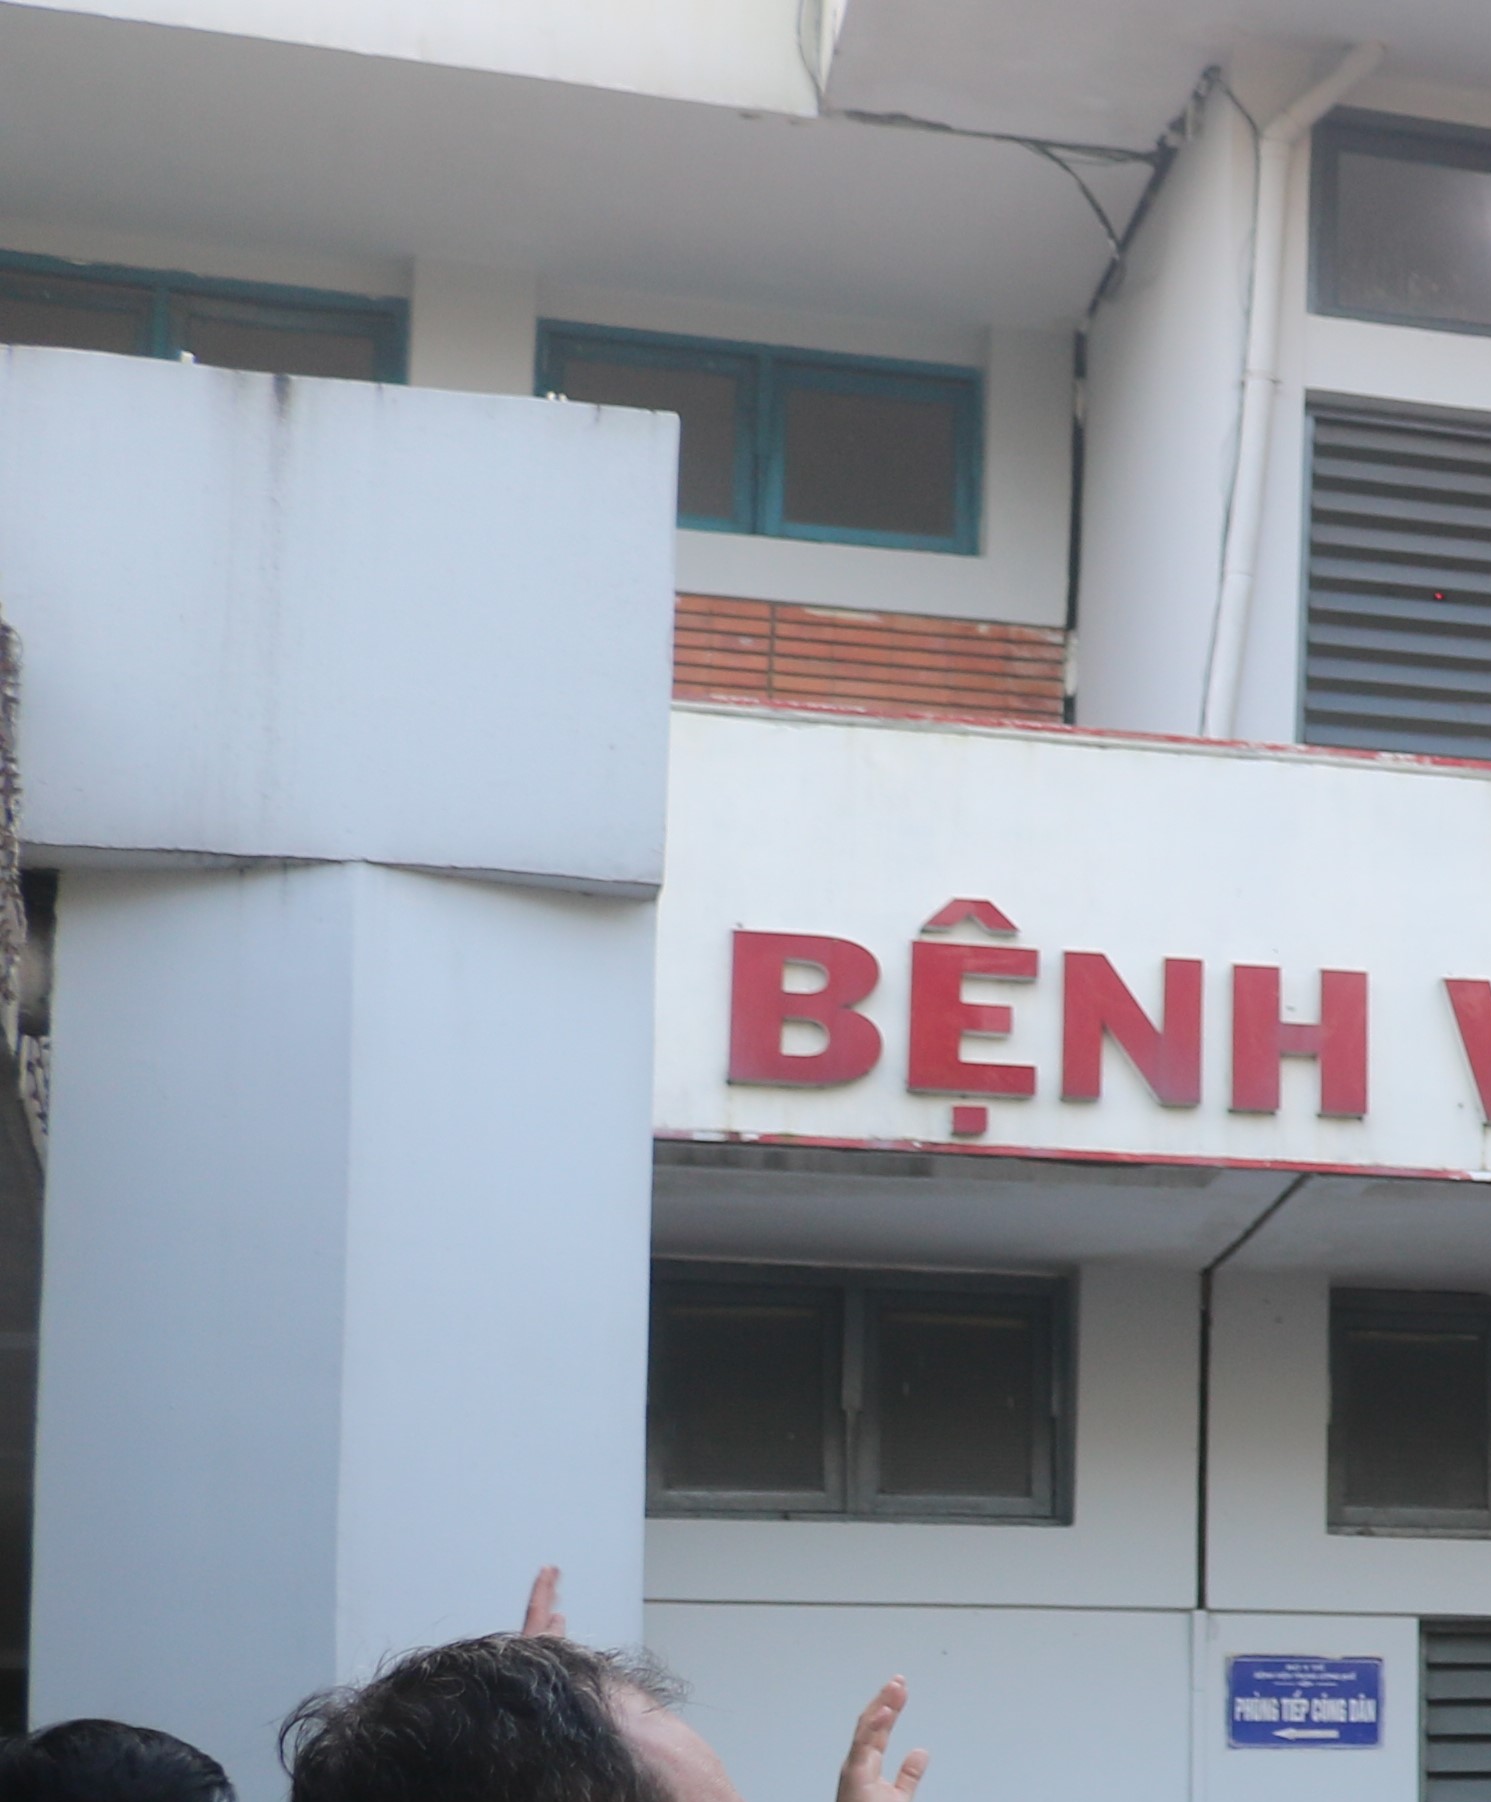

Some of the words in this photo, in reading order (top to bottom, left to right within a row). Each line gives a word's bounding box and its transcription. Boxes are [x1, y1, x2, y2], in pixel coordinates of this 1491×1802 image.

[728, 898, 1370, 1136] BỆNH
[1233, 1690, 1280, 1722] PHÒNG
[1281, 1689, 1310, 1722] TIẾP
[1311, 1692, 1347, 1722] CÔNG
